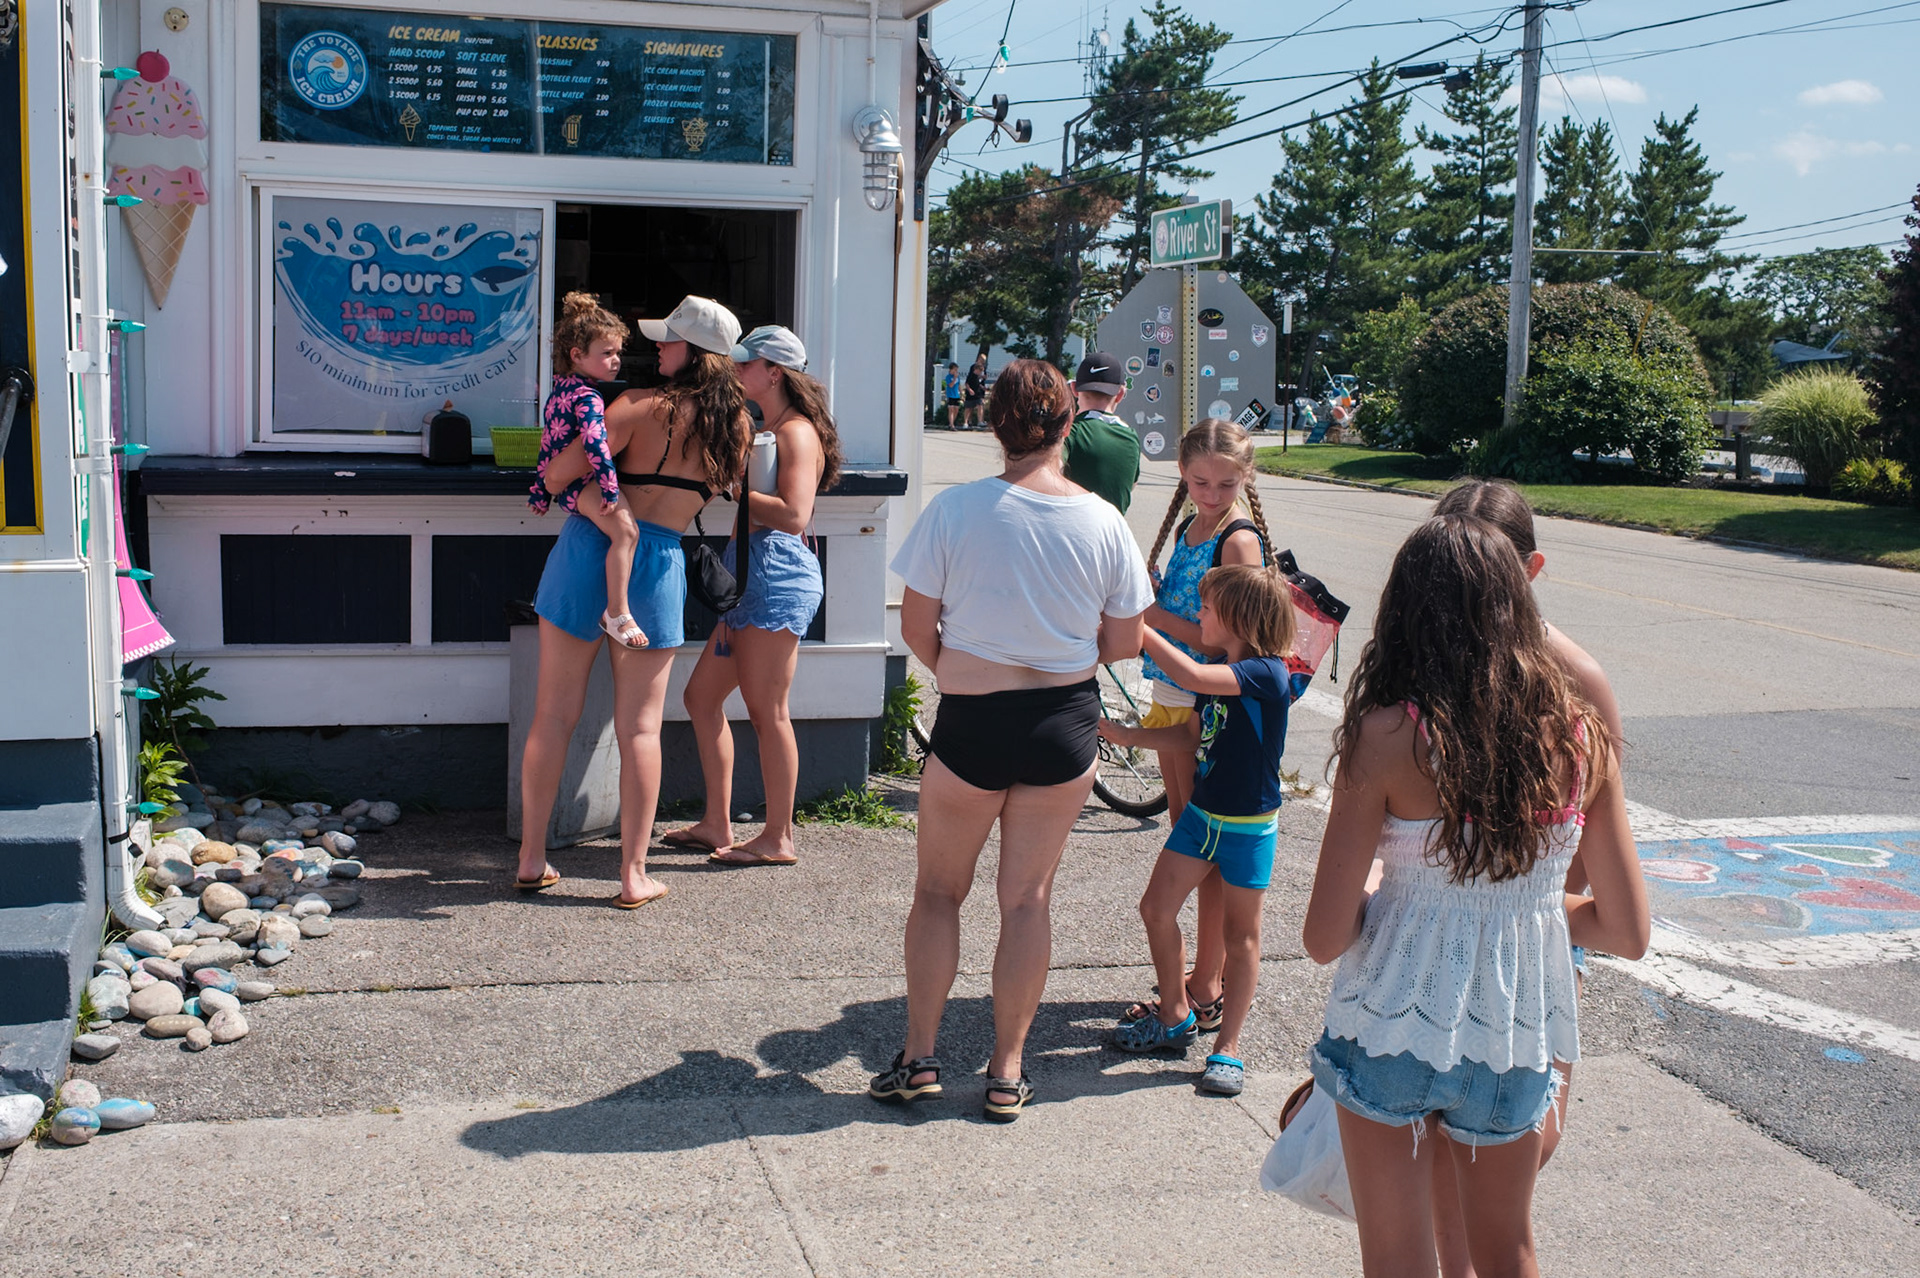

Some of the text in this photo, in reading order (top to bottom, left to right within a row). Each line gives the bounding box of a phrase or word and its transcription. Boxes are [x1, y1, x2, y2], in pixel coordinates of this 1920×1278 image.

[388, 26, 412, 40] ICE
[415, 27, 460, 42] CREAM
[536, 35, 599, 51] CLASSICS
[297, 36, 359, 61] THE VOYAGE
[389, 47, 445, 59] HARD SCOOP
[643, 41, 725, 58] SIGNATURES
[456, 51, 507, 62] SOFT SERVE
[536, 57, 573, 66] MILKSHAKE
[394, 63, 418, 72] SCOOP
[426, 65, 442, 73] 4.75
[456, 67, 477, 75] SMALL
[644, 66, 656, 74] ICE
[656, 67, 678, 76] CREAM
[679, 68, 706, 77] NACHOS
[388, 76, 394, 84] 2
[395, 76, 419, 85] SCOOP
[536, 74, 570, 83] ROOTBEER
[456, 80, 478, 88] LARGE
[644, 83, 656, 91] ICE
[656, 84, 678, 92] CREAM
[679, 84, 703, 93] FLIGHT
[296, 77, 360, 104] ICE CREAM
[389, 90, 394, 98] 3
[395, 91, 420, 99] SCOOP
[536, 90, 560, 98] BOTTLE
[562, 91, 584, 99] WATER
[456, 95, 507, 104] IRISH 99 5.65
[643, 99, 669, 107] FROZEN
[669, 100, 705, 109] LEMONADE
[456, 108, 509, 117] PUP CUP 2.00
[536, 105, 554, 114] SODA
[643, 116, 676, 125] SLUSHIES
[1170, 209, 1217, 257] River St
[351, 263, 463, 295] Hours
[341, 301, 395, 320] 11am
[417, 303, 476, 325] 10pm
[342, 324, 473, 347] 7 days/week
[322, 363, 399, 398] minimum
[404, 384, 428, 398] for
[434, 373, 481, 396] credit
[484, 349, 518, 380] card
